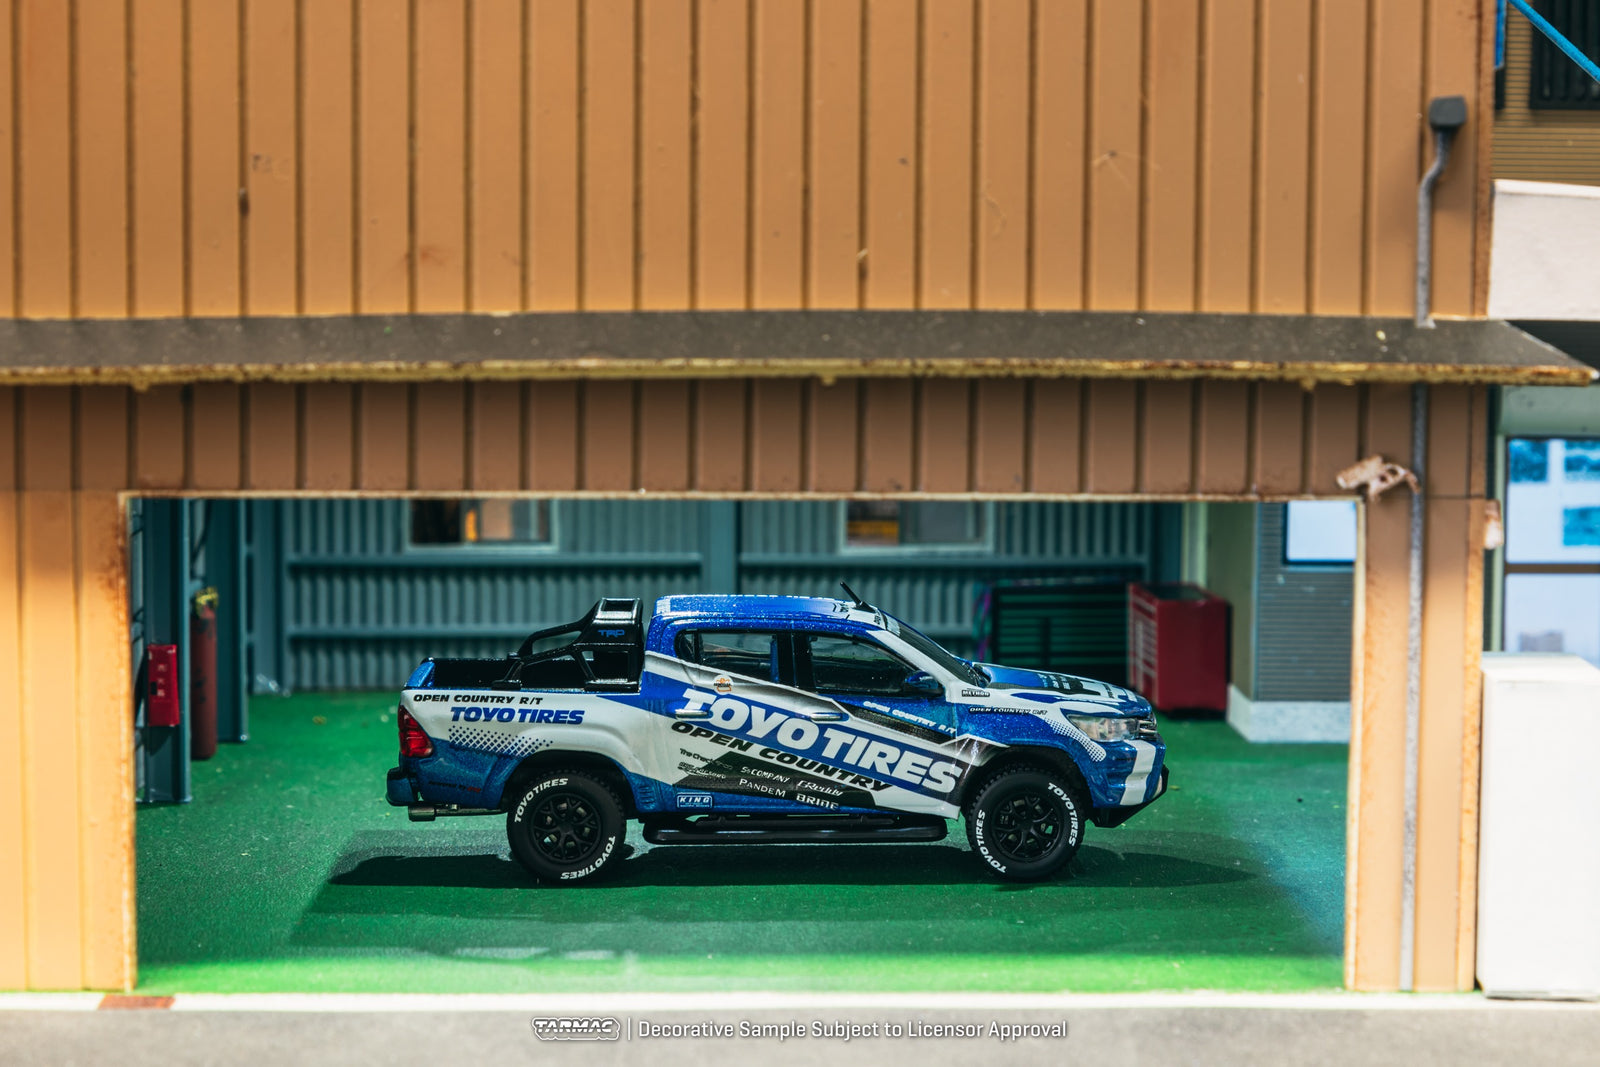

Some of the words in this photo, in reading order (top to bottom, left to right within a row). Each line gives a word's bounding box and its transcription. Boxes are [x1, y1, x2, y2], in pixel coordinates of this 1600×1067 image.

[598, 629, 625, 638] TRD
[413, 694, 450, 702] OPEN
[454, 695, 515, 704] COUNTRY
[519, 697, 543, 705] R/T
[863, 700, 890, 712] OPEN
[892, 708, 936, 728] COUNTRY
[938, 724, 957, 734] R/T
[671, 722, 754, 752] OPEN
[758, 748, 893, 792] COUNTRY
